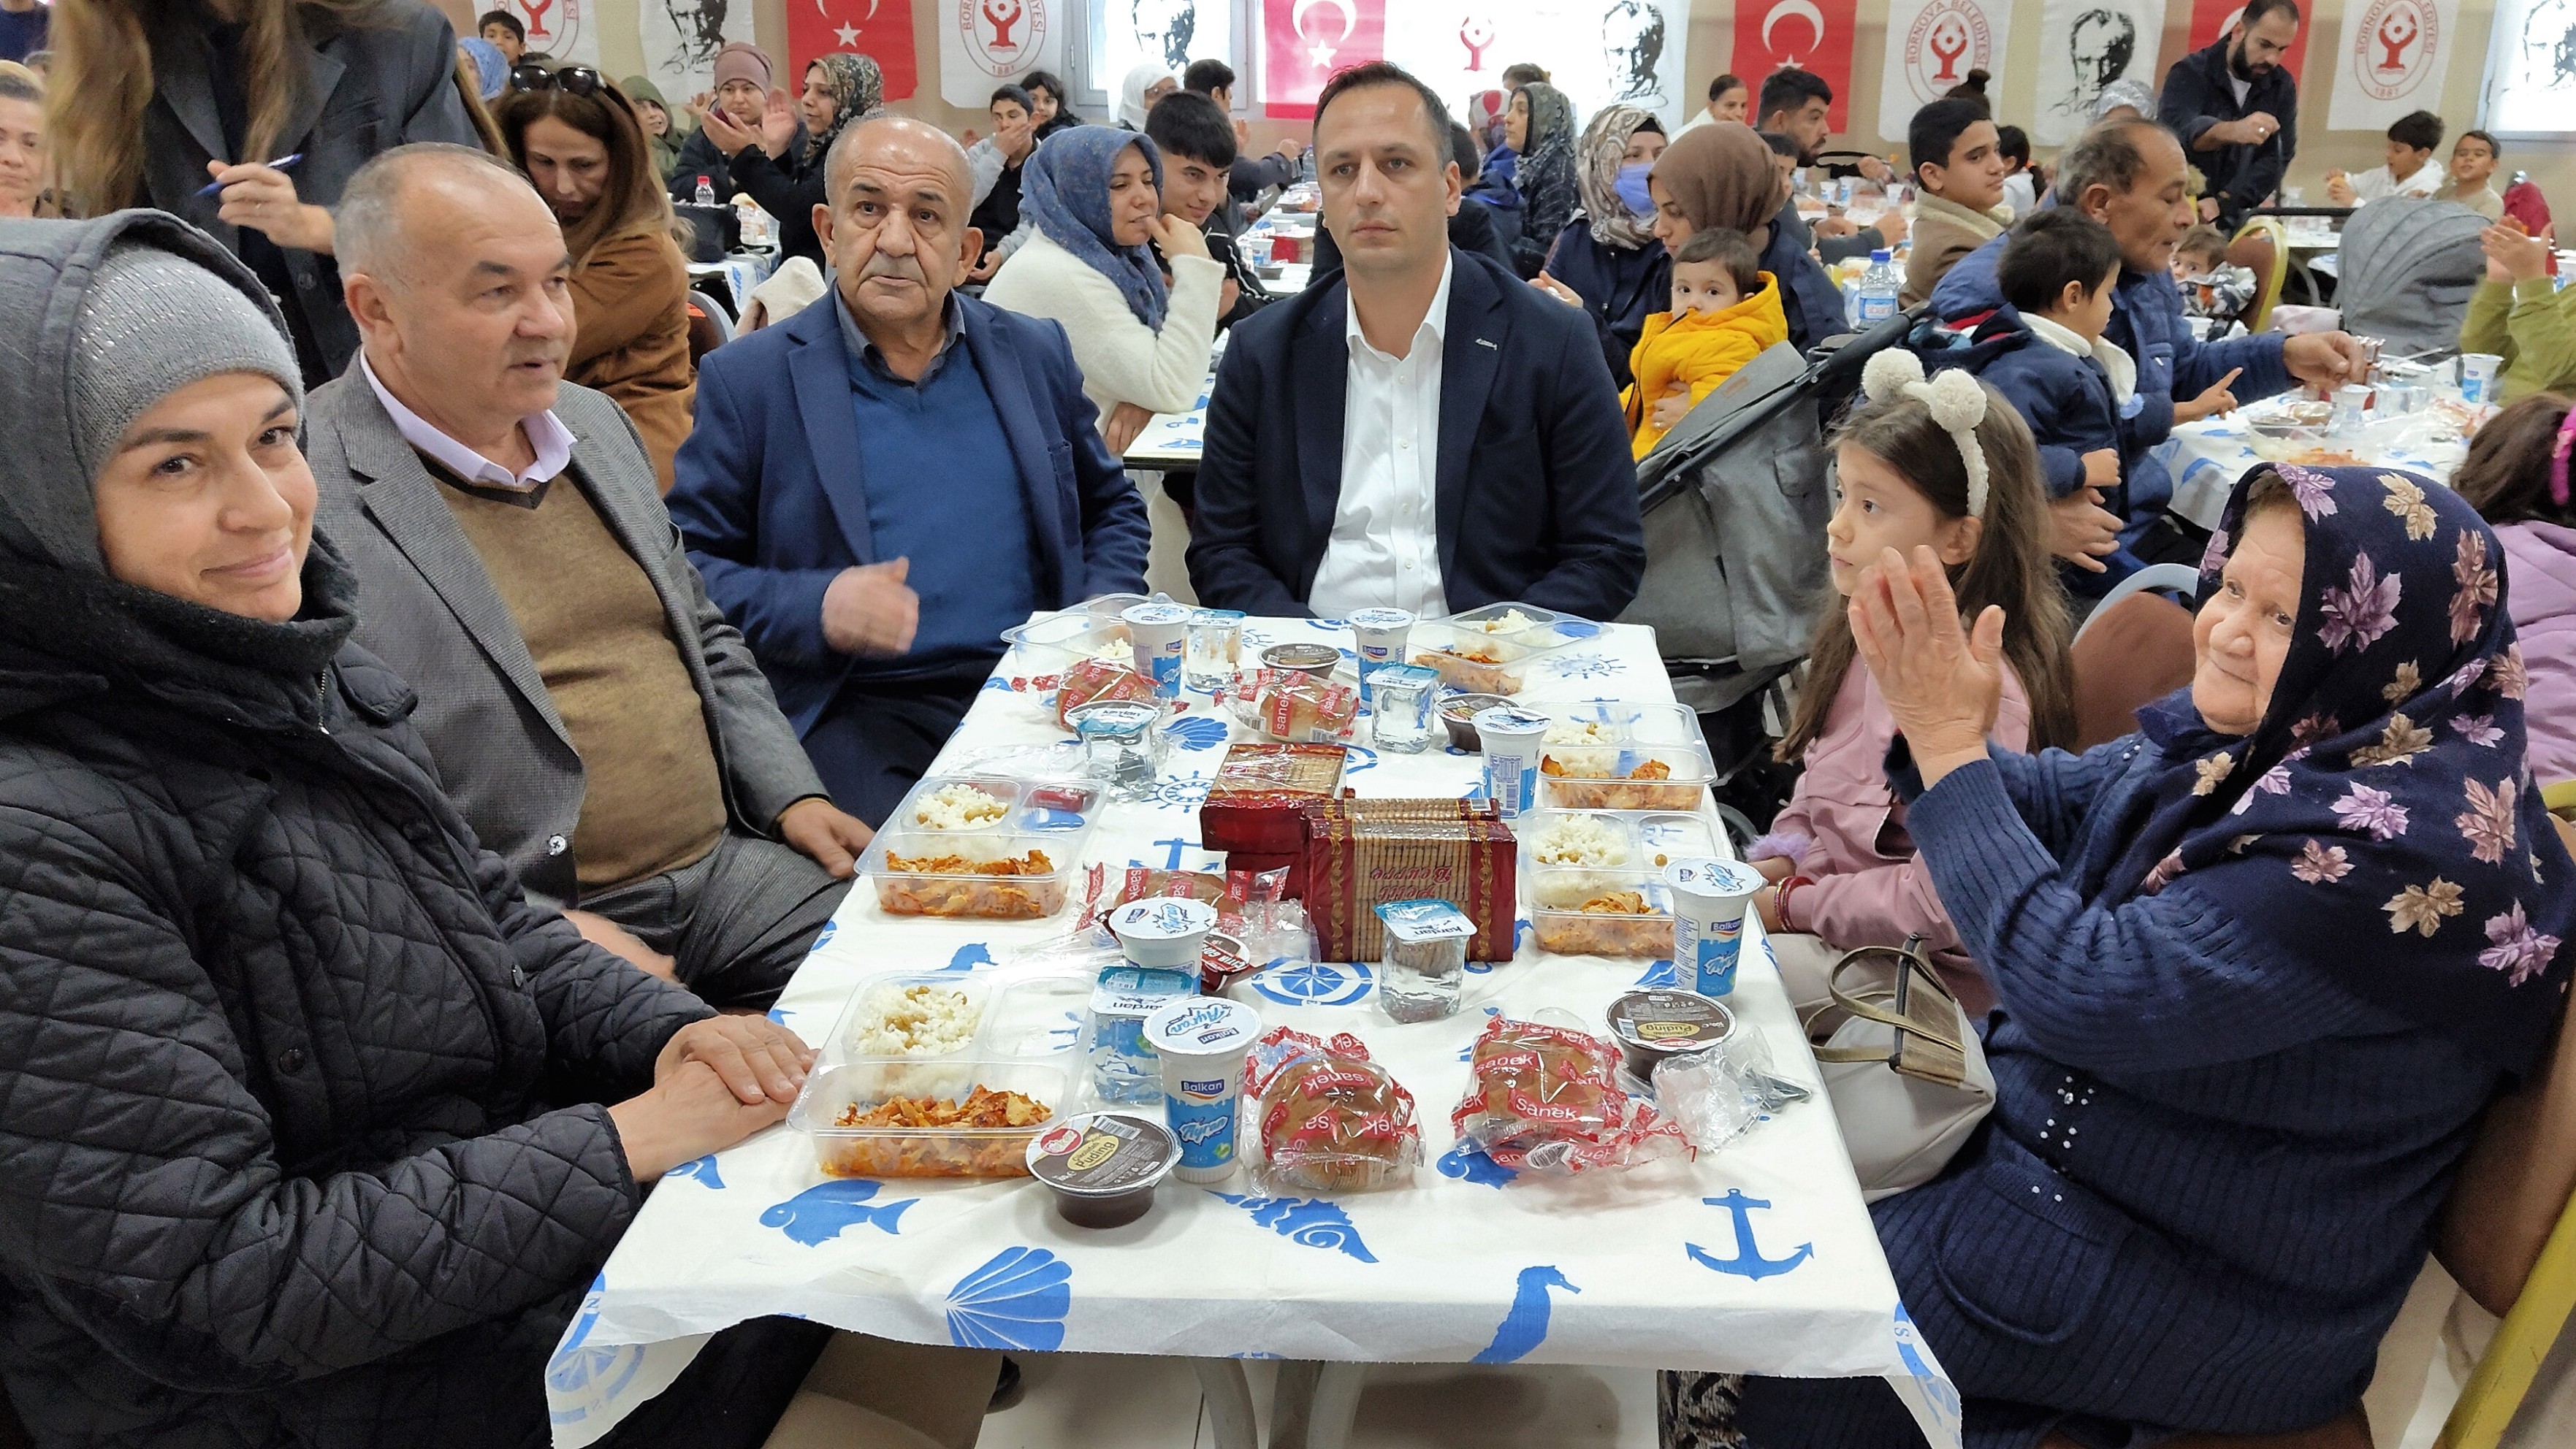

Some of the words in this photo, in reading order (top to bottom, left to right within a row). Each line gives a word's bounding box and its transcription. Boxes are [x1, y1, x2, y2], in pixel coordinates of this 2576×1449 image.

[1371, 865, 1452, 884] Beurre
[1113, 1001, 1163, 1011] ardan
[1170, 1006, 1226, 1033] Ayran
[1647, 1023, 1692, 1034] Puding
[1476, 1055, 1533, 1071] sanek
[1183, 1080, 1223, 1093] Balkan
[1304, 1071, 1365, 1091] sanek
[1515, 1098, 1577, 1119] sanek
[1075, 1141, 1116, 1168] Puding
[1894, 1327, 1910, 1337] S
